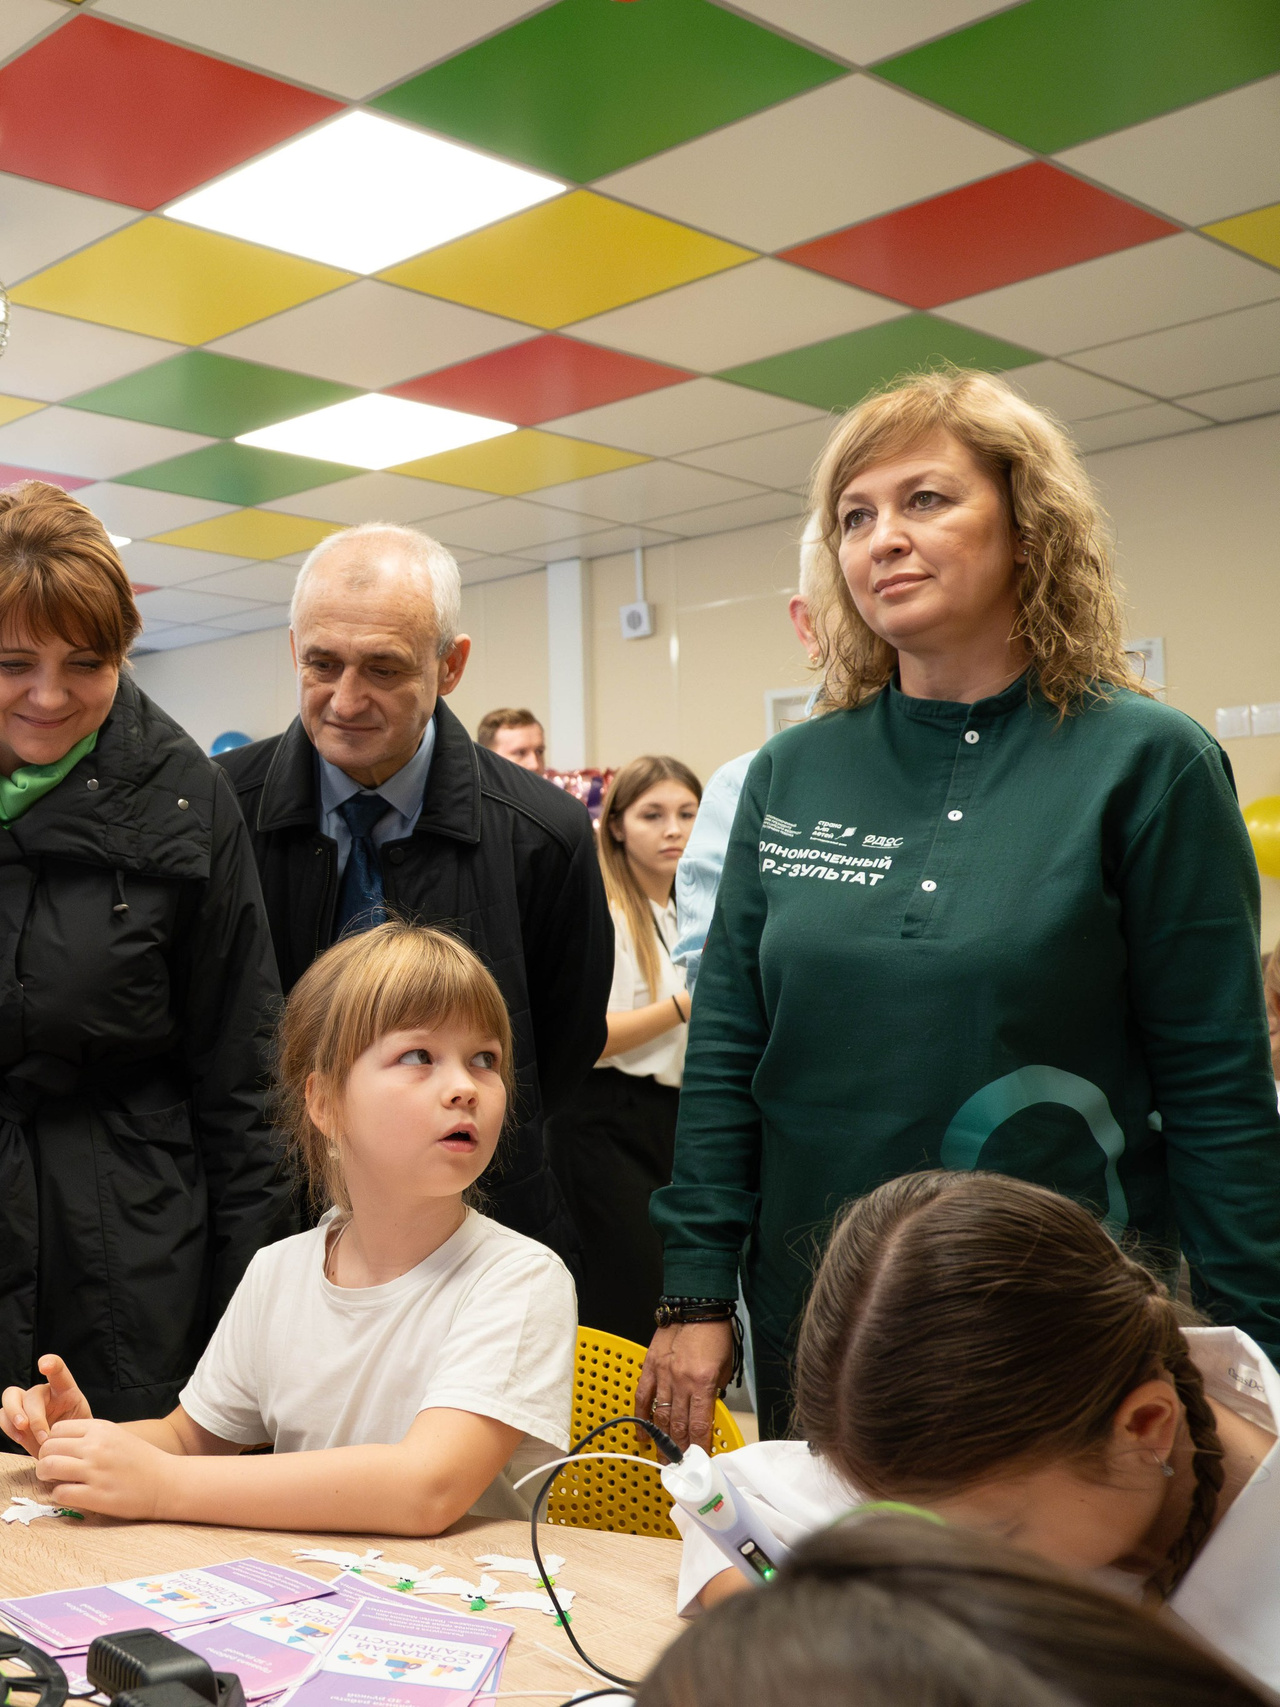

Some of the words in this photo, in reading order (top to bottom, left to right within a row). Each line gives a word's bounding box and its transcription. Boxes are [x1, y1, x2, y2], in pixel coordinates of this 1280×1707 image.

[759, 840, 893, 870] ОЛНОМОЧЕННЫЙ
[348, 1633, 484, 1660] РЕАЛЬНОСТЬ
[356, 1642, 471, 1665] СОЗДАВАЙ
